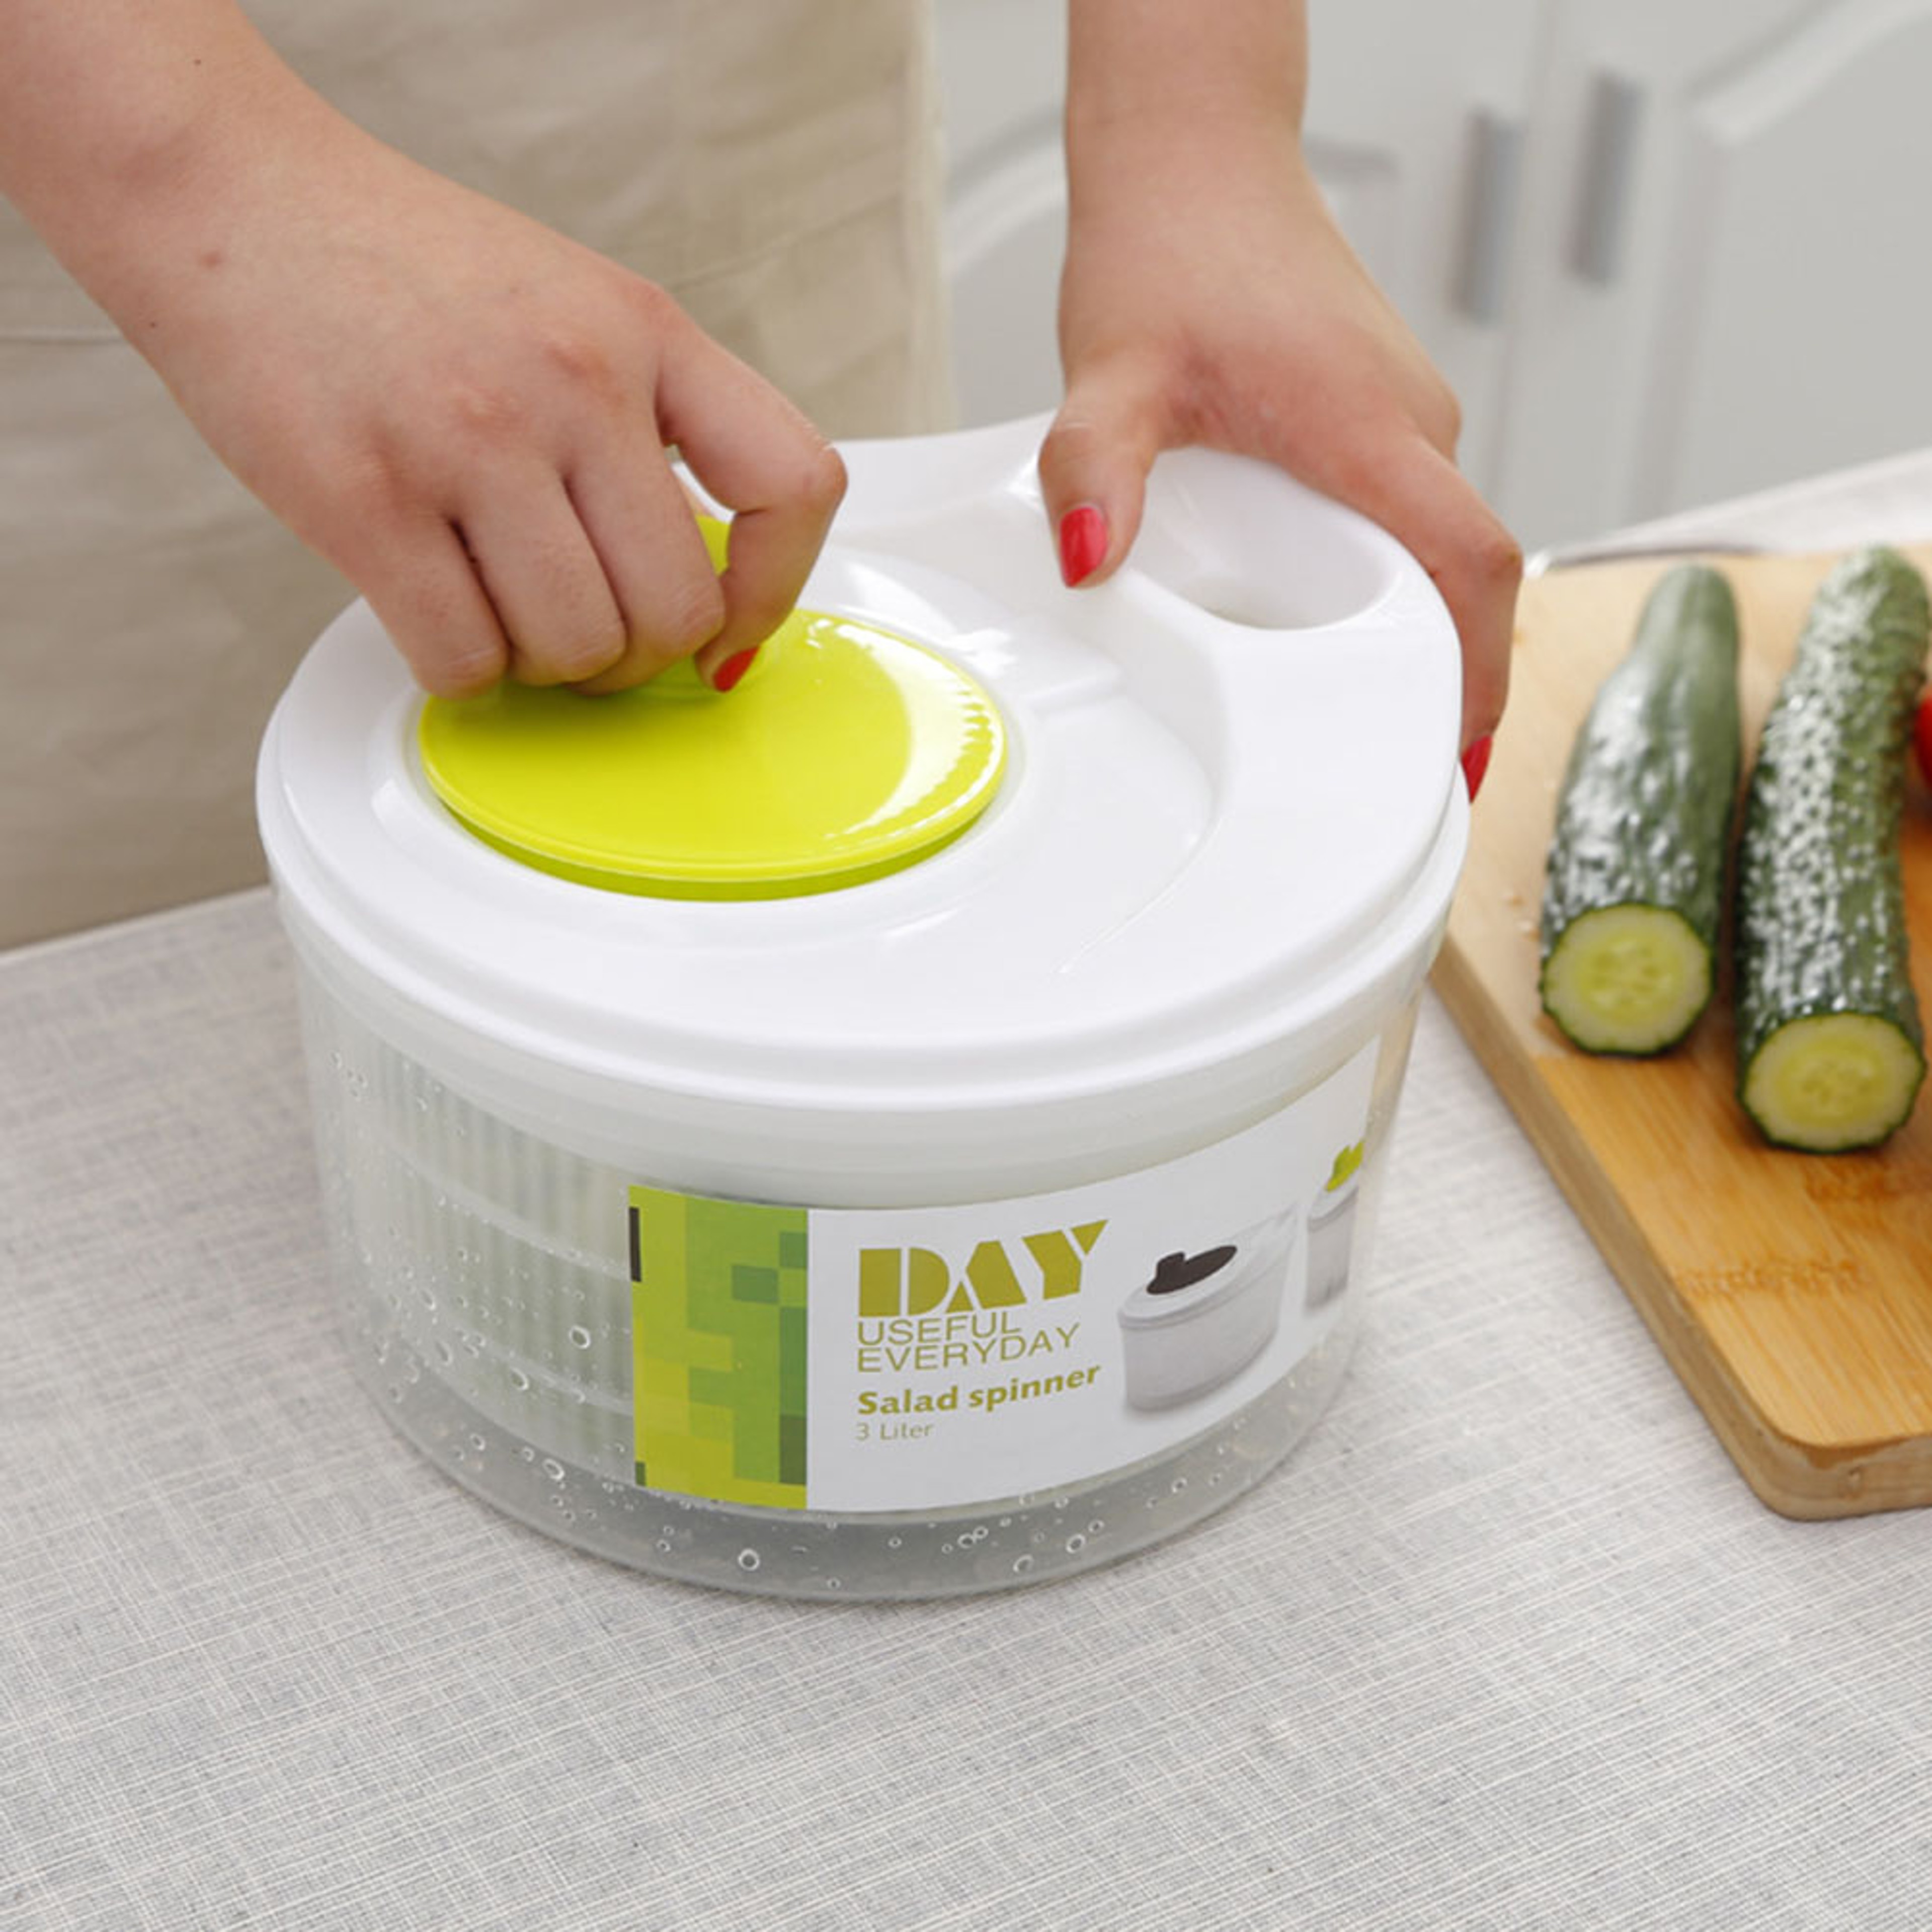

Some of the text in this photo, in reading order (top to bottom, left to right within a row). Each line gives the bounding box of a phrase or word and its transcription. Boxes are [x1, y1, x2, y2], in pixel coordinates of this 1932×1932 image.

[858, 1219, 1109, 1317] DAY
[857, 1311, 1021, 1346] USEFUL
[857, 1323, 1080, 1373] EVERYDAY
[858, 1365, 1101, 1415] Salad spinner
[856, 1422, 934, 1441] 3 Liter
